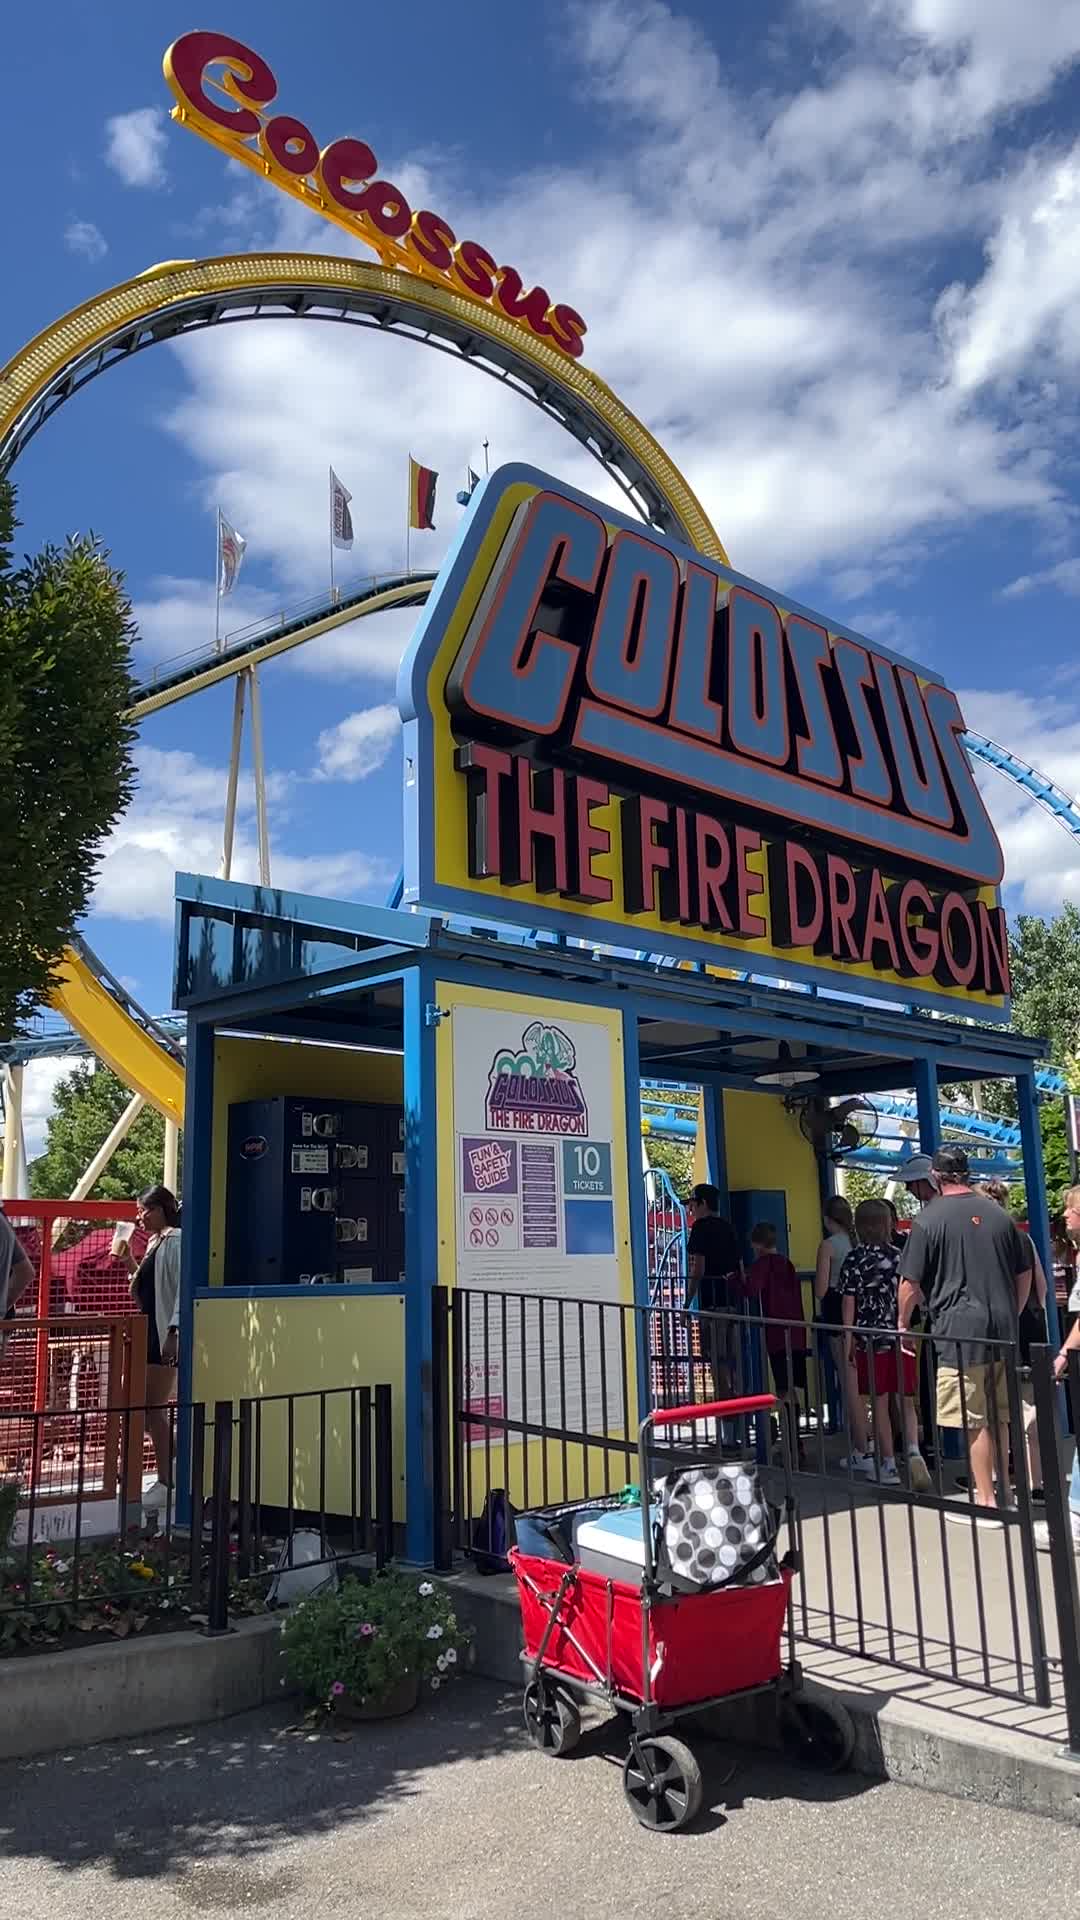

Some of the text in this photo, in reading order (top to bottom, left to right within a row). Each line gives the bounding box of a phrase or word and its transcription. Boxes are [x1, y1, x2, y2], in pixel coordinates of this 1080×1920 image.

[448, 490, 1004, 886] COLOSSUS
[456, 742, 1011, 996] THE FIRE DRAGON
[489, 1073, 585, 1116] COLOSSUS
[490, 1108, 585, 1133] THE FIRE DRAGON
[471, 1143, 501, 1162] FUN &
[474, 1150, 512, 1176] SAFETY
[574, 1146, 601, 1176] 10
[476, 1168, 509, 1188] GUIDE
[572, 1180, 604, 1191] TICKETS
